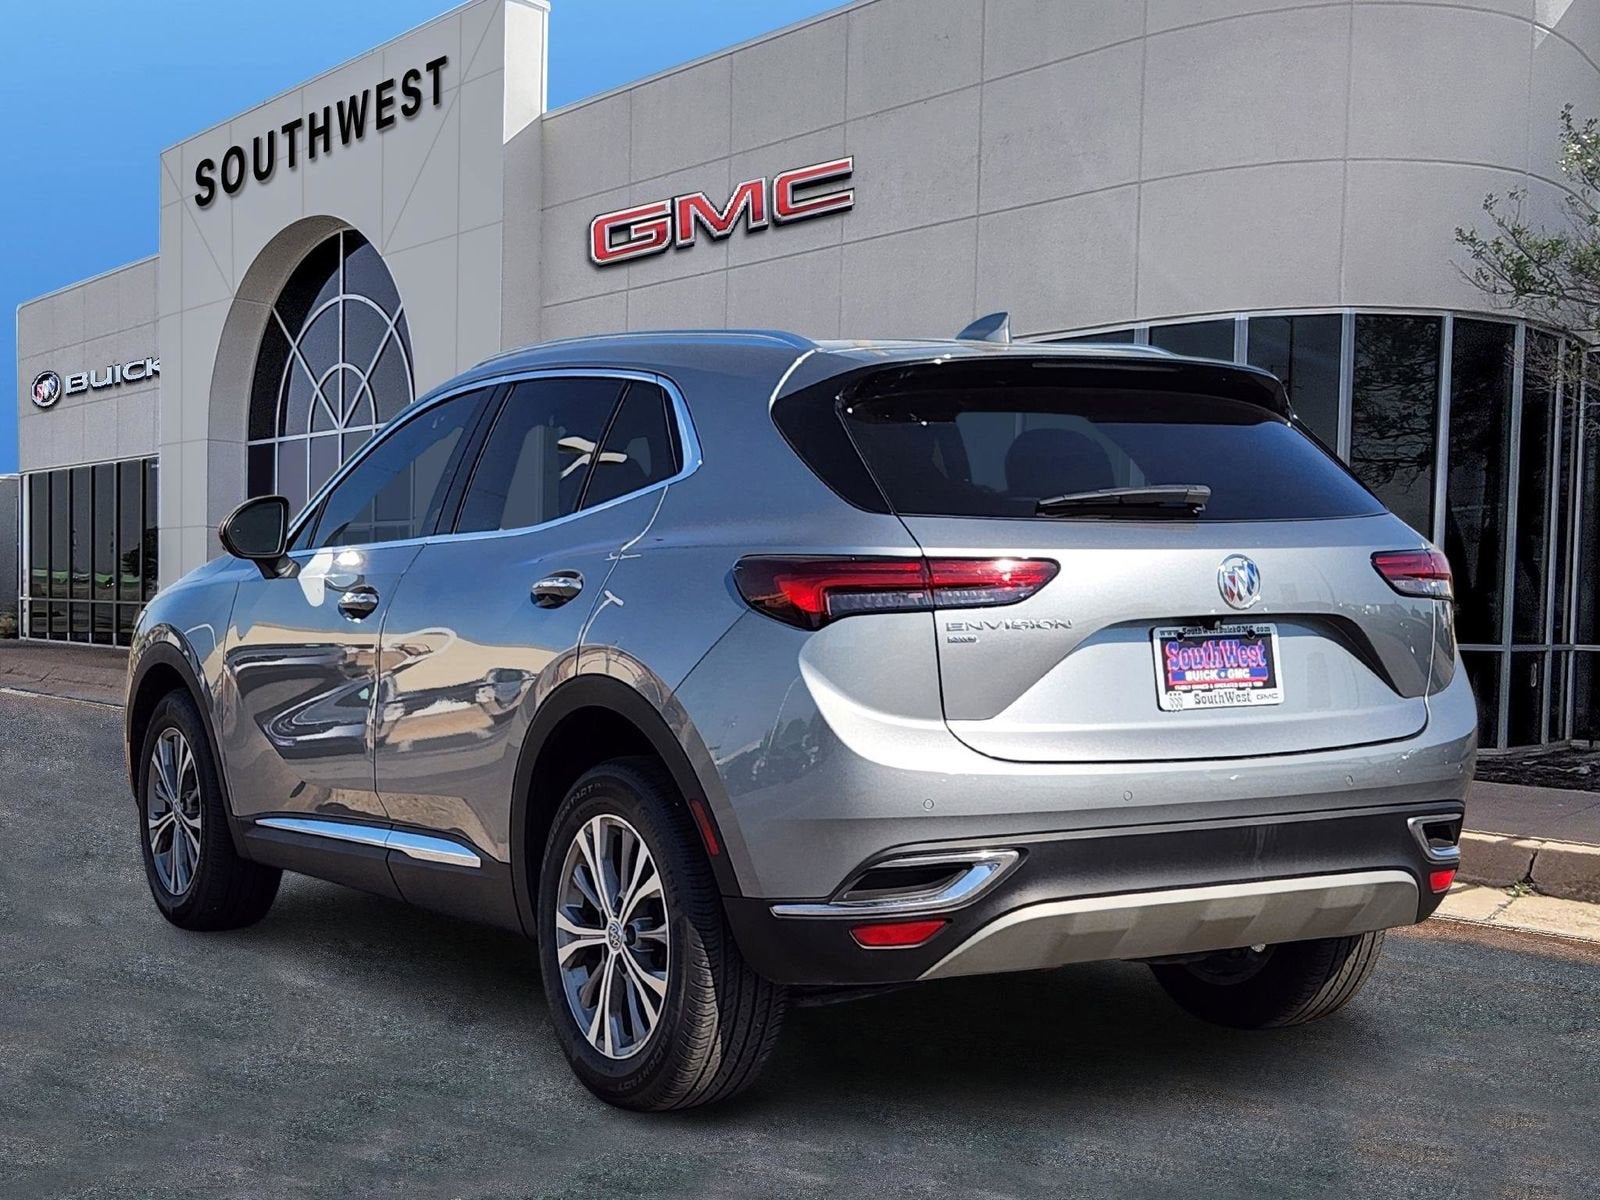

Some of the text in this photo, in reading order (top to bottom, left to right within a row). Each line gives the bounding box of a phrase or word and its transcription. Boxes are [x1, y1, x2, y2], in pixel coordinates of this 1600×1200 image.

[195, 55, 448, 208] SOUTHWEST
[590, 155, 855, 266] GMC
[65, 356, 160, 396] BUICK
[945, 619, 1073, 632] ENVISION
[1165, 640, 1267, 671] SouthWest
[1184, 667, 1251, 681] BUICK GMC
[1194, 691, 1279, 705] SouthWest GMC
